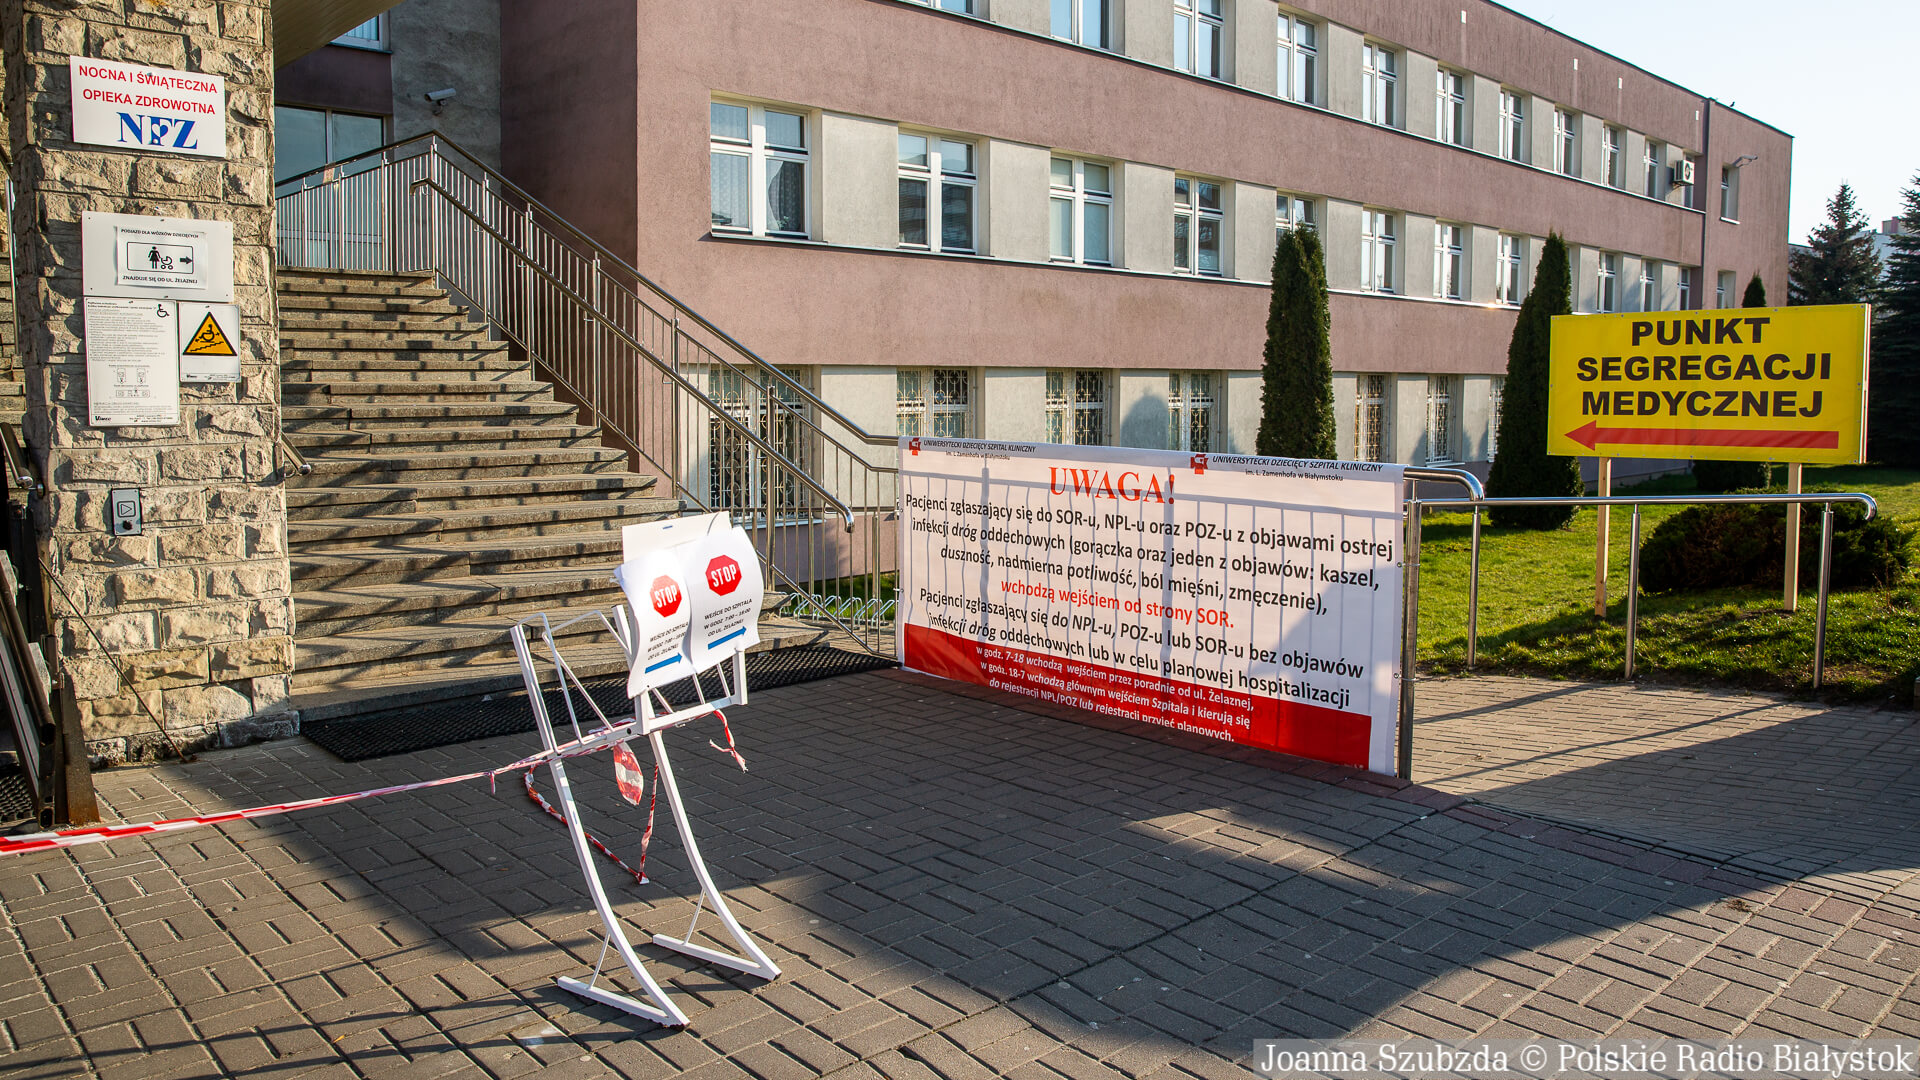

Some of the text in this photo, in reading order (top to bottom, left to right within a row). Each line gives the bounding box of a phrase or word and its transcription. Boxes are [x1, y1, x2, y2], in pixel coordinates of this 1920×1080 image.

[79, 65, 218, 93] NOCNA I ŚWIĄTECZNA
[83, 88, 215, 114] OPIEKA ZDROWOTNA
[116, 111, 198, 150] NFZ
[1631, 317, 1770, 346] PUNKT
[1576, 352, 1831, 382] SEGREGACJI
[1582, 390, 1823, 418] MEDYCZNEJ
[923, 440, 1036, 453] UNIWERSYTECKI DZIECIĘCY SZPITAL KLINICZNY
[1212, 455, 1383, 472] UNIWERSYTECKI DZIECIĘCY SZPITAL KLINICZNY
[1304, 472, 1344, 482] Białymstoku
[1048, 466, 1175, 505] UWAGA!
[906, 493, 1393, 562] Pacjenci zgłaszający się do SOR-u, NPL-u oraz POZ-u z objawami ostrej
[913, 517, 1379, 591] infekcji dróg oddechowych (gorączka oraz jeden z objawów: kaszel,
[711, 564, 737, 587] STOP
[940, 544, 1328, 616] duszność, nadmierna potliwość, ból mięśni, zmęczenie),
[654, 584, 678, 608] STOP
[704, 608, 724, 620] WEJŚCIE
[732, 598, 752, 610] SZPITALA
[1001, 579, 1234, 628] wchodzą wejściem od strony SOR.
[723, 618, 744, 631] ŻELAZNEJ
[725, 613, 735, 621] 7:00
[920, 588, 1364, 679] Pacjenci zgłaszający się do NPL-u, POZ-u lub SOR-u bez objawów
[929, 612, 1350, 709] infekcji dróg oddechowych lub w celu planowej hospitalizacji
[976, 646, 1254, 711] w godz. 7-18 wchodzą wejściem przez poradnie od ul. Żelaznej,
[989, 677, 1000, 688] do
[1001, 681, 1039, 699] rejestracji
[1040, 689, 1078, 707] NPL/POZ
[1079, 698, 1093, 709] lub
[980, 661, 987, 670] w
[988, 663, 1008, 675] godz.
[1008, 667, 1025, 679] 18-7
[1026, 671, 1065, 690] wchodzą
[1066, 679, 1106, 697] głównym
[1107, 688, 1150, 707] wejściem
[1151, 697, 1189, 715] Szpitala
[1191, 704, 1195, 716] i
[1197, 708, 1233, 727] kierują
[1235, 714, 1251, 730] się
